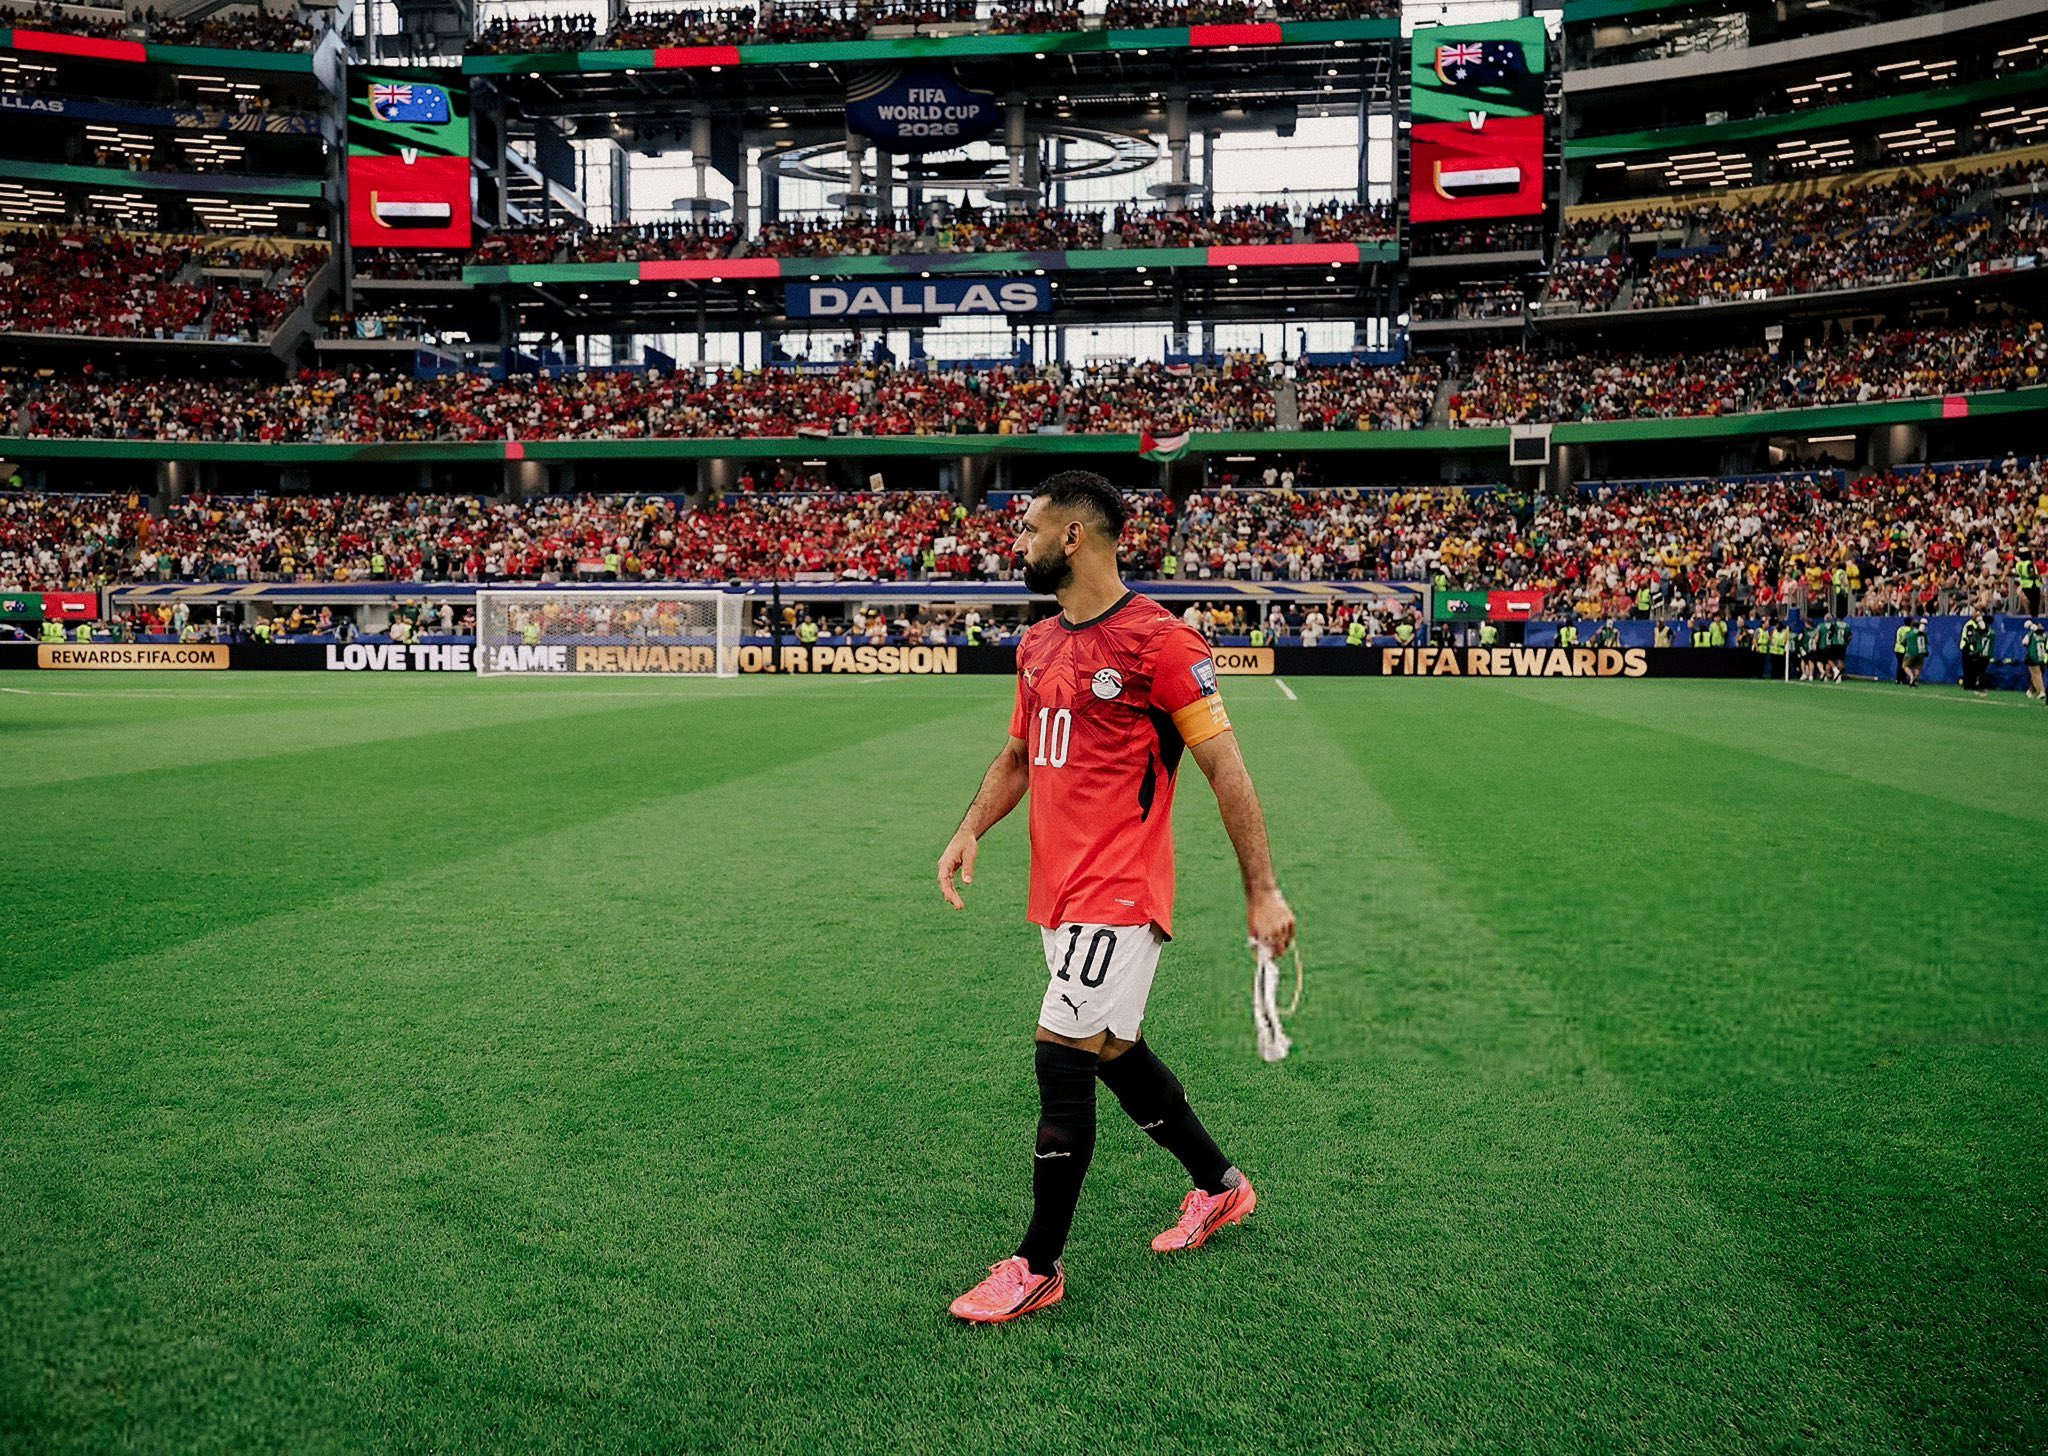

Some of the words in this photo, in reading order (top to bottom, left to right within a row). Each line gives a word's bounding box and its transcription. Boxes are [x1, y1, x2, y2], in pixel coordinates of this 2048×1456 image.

[0, 96, 65, 112] LLAS
[908, 88, 947, 103] FIFA
[878, 105, 941, 120] WORLD
[944, 105, 980, 119] CUP
[898, 122, 959, 136] 2026
[809, 282, 1038, 315] DALLAS
[51, 650, 216, 664] REWARDS.FIFA.COM
[326, 644, 407, 671] LOVE
[409, 645, 470, 671] THE
[473, 645, 568, 672] GAME
[575, 645, 714, 673] REWARD
[719, 645, 809, 673] YOUR
[812, 646, 957, 673] PASSION
[1382, 648, 1461, 675] FIFA
[1467, 648, 1648, 677] REWARDS
[1034, 707, 1072, 768] 10
[1057, 924, 1117, 988] 10
